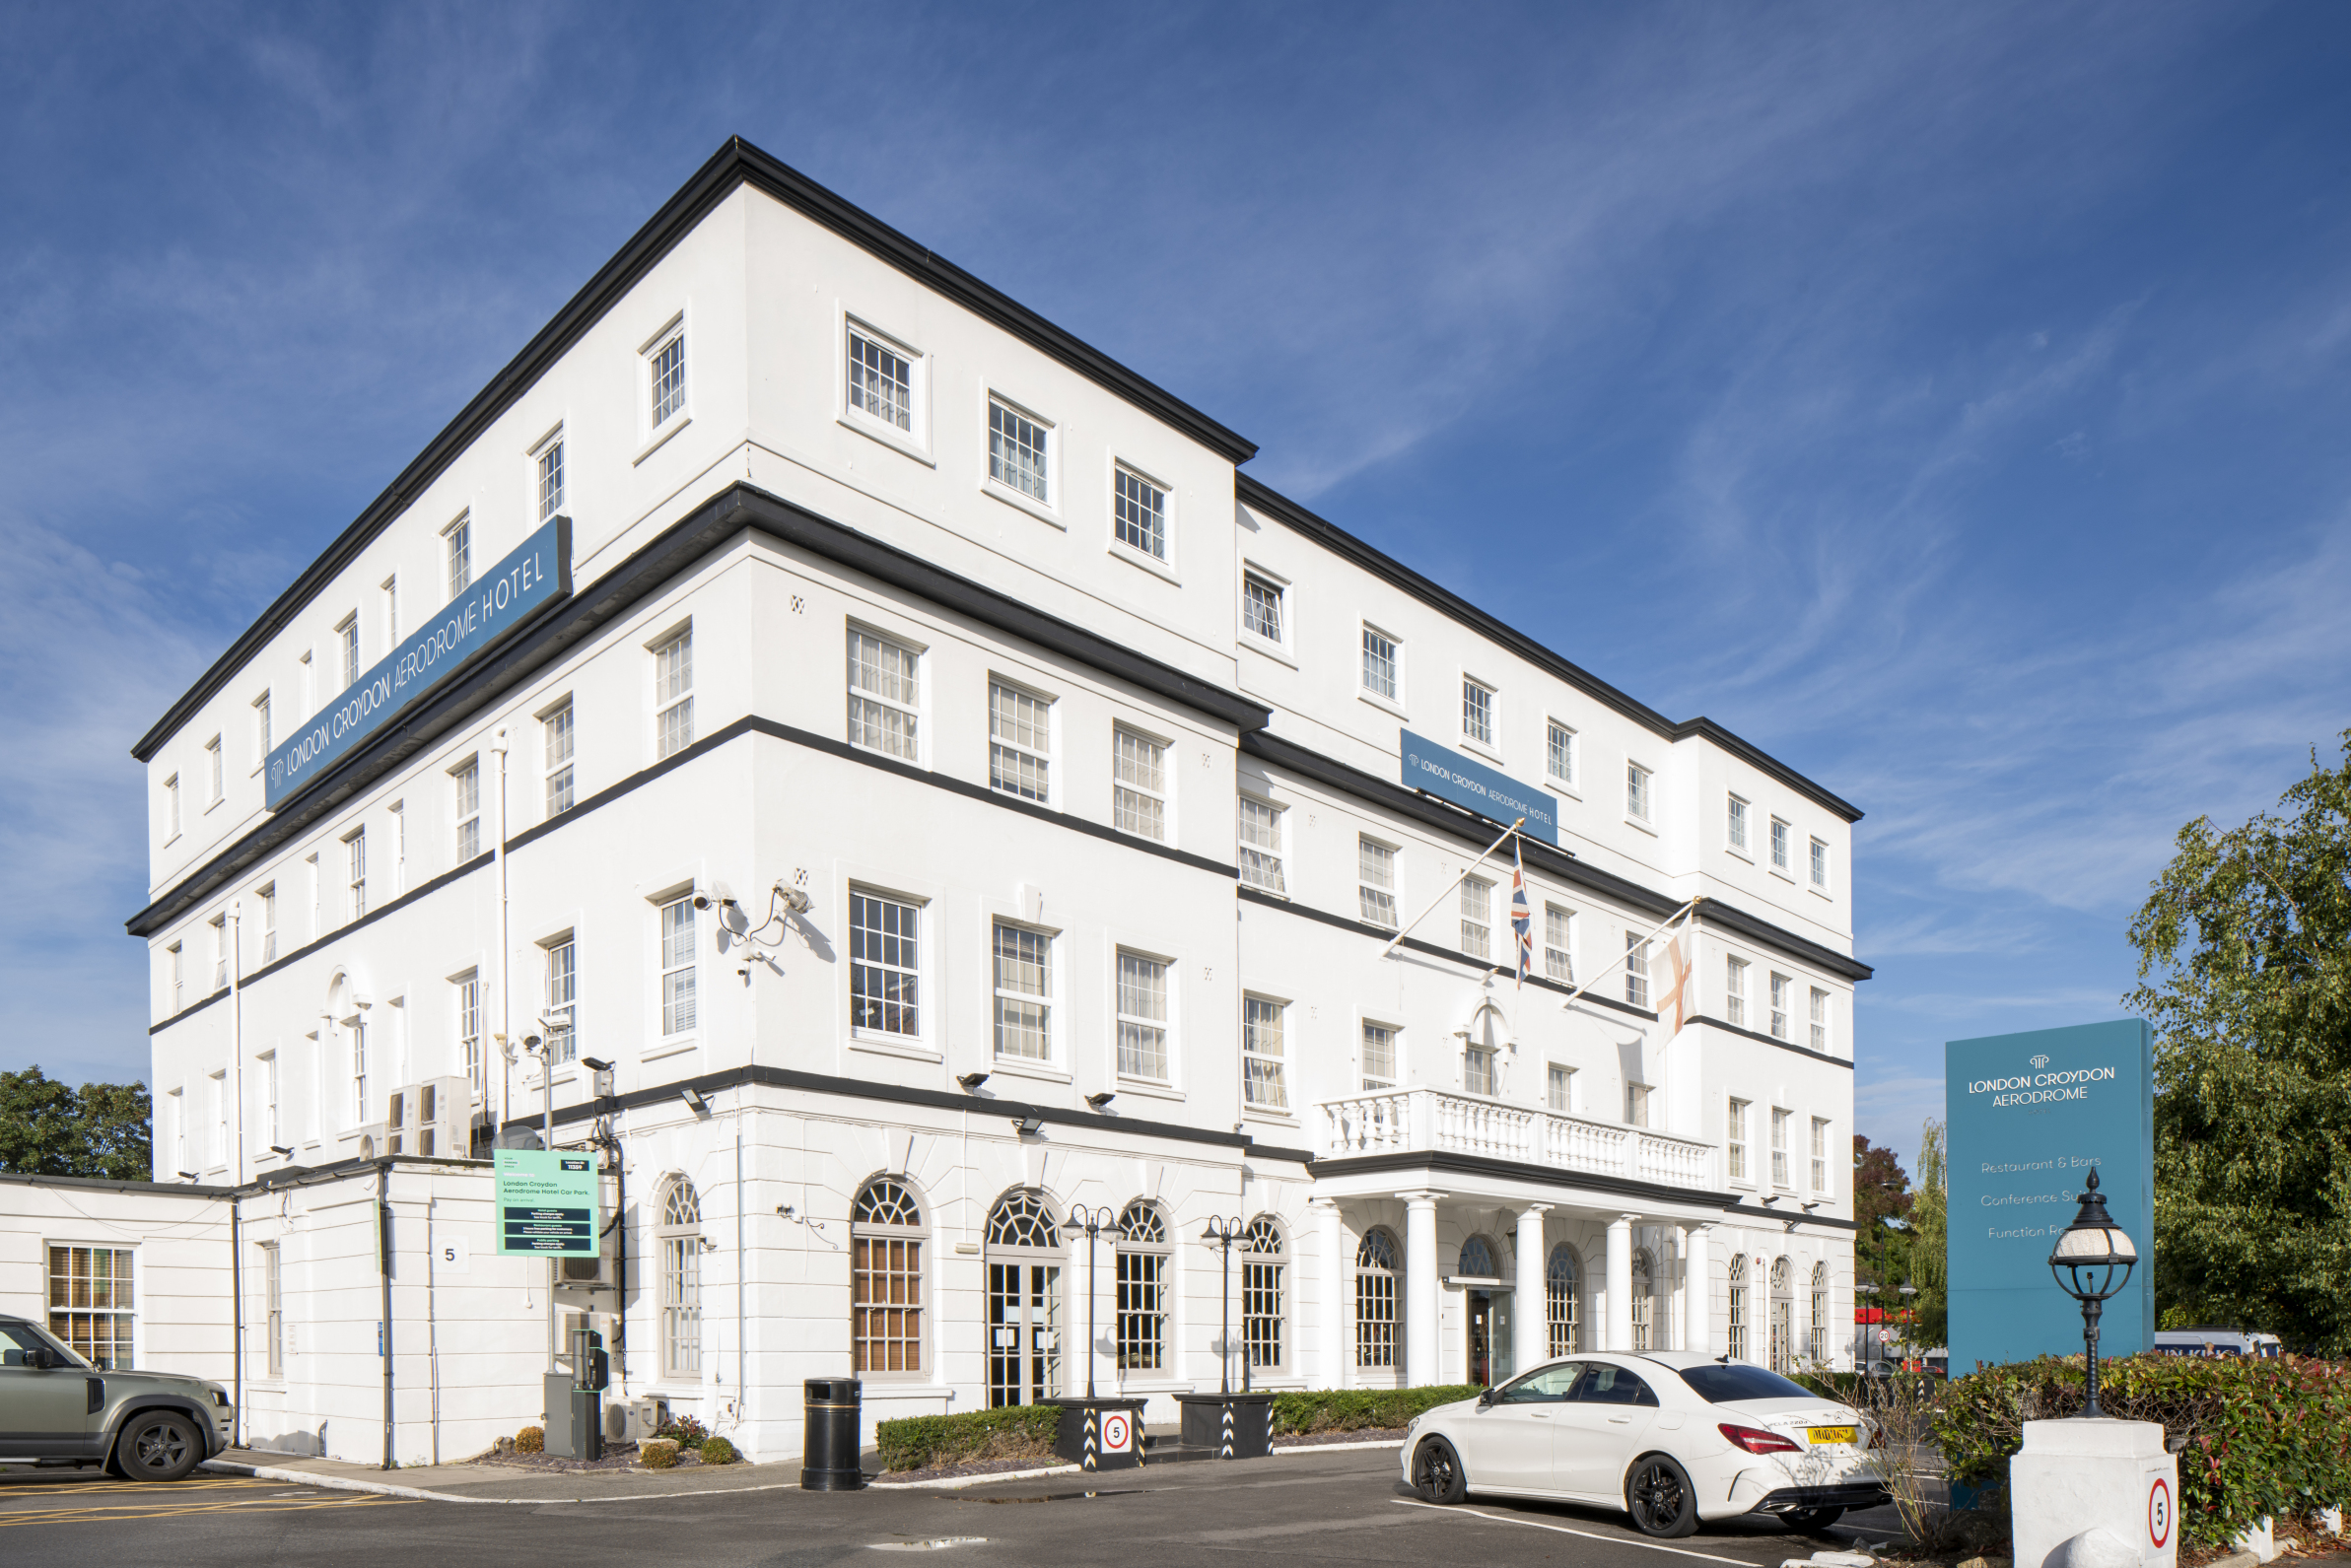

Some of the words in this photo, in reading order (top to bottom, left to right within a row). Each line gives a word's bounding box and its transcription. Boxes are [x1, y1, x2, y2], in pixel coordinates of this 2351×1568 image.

[287, 723, 329, 776] LONDON
[332, 672, 390, 739] CROYDON
[394, 600, 477, 693] AERODROME
[482, 552, 543, 623] HOTEL
[1420, 759, 1450, 781] LONDON
[1451, 773, 1487, 796] CROYDON
[1488, 789, 1528, 815] AERODROME
[1529, 806, 1553, 826] HOTEL
[1969, 1075, 2031, 1094] LONDON
[2035, 1066, 2115, 1087] CROYDON
[1992, 1086, 2088, 1108] AERODROME
[1981, 1158, 2054, 1173] Restaurant
[2057, 1156, 2067, 1169] &
[2071, 1155, 2103, 1168] Bars
[1980, 1193, 2058, 1206] Conference
[1988, 1225, 2045, 1239] Function
[445, 1248, 455, 1261] 5
[1113, 1427, 1120, 1438] 5
[2157, 1502, 2163, 1526] 5
